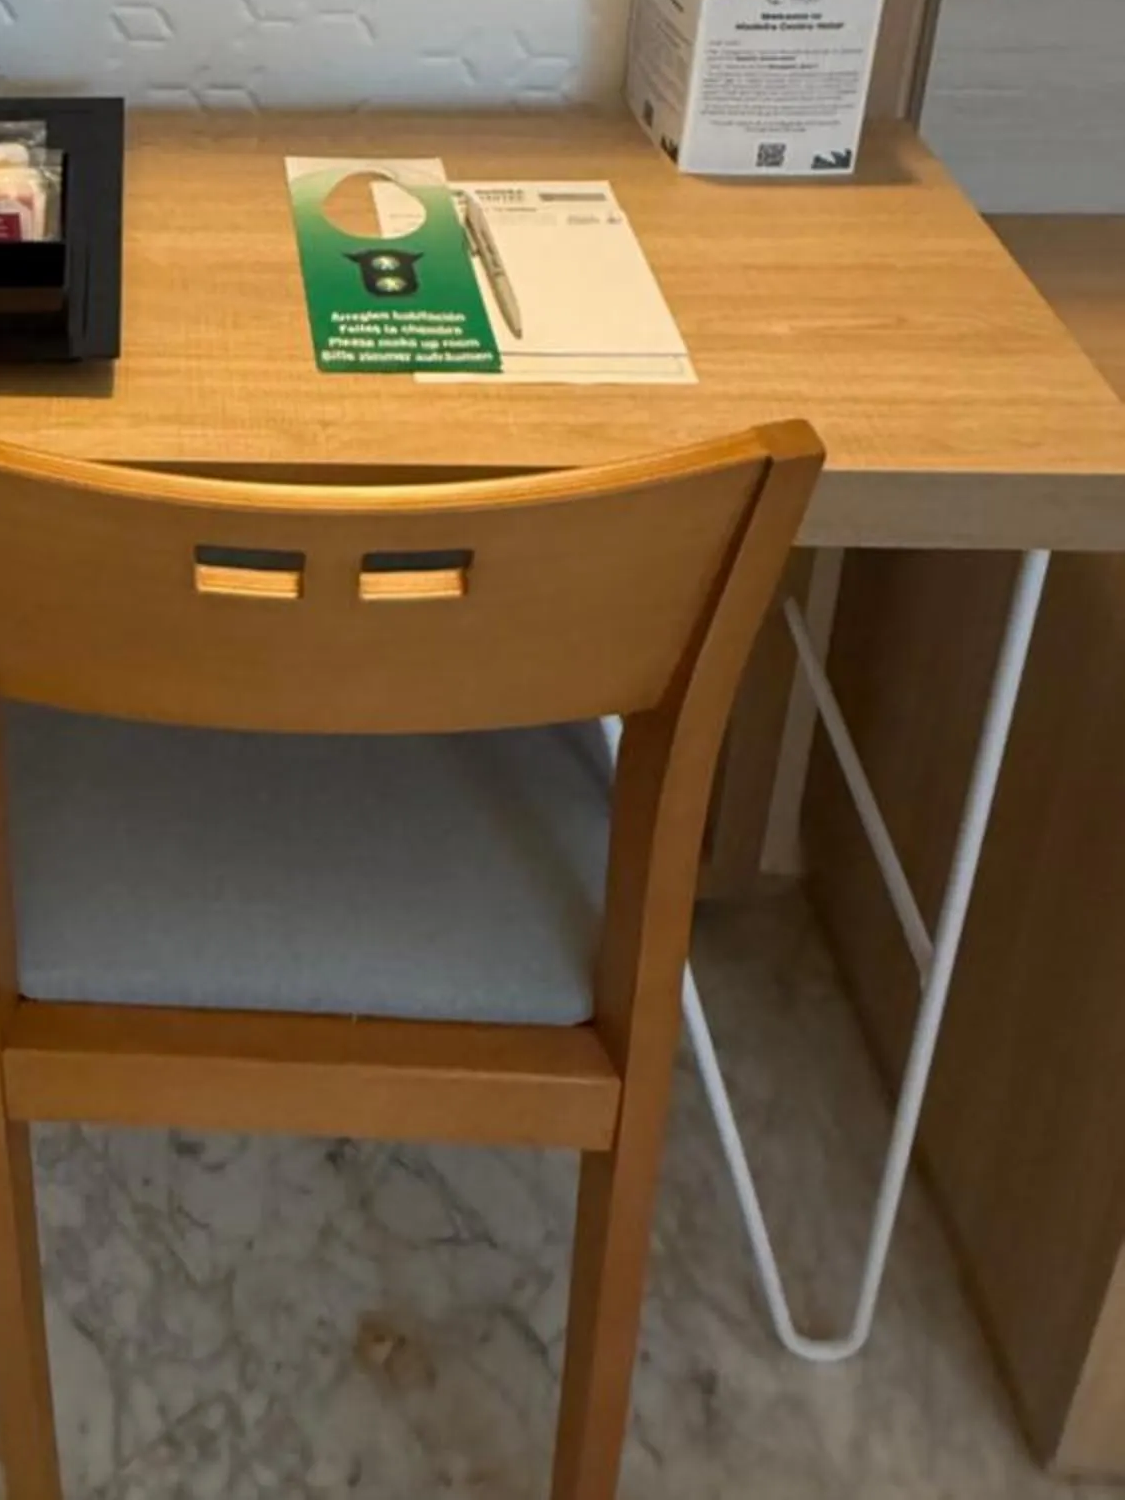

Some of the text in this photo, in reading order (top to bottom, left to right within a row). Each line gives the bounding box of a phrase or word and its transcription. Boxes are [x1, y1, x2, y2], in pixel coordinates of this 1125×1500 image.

[383, 324, 398, 335] la
[328, 337, 480, 349] Please make up room
